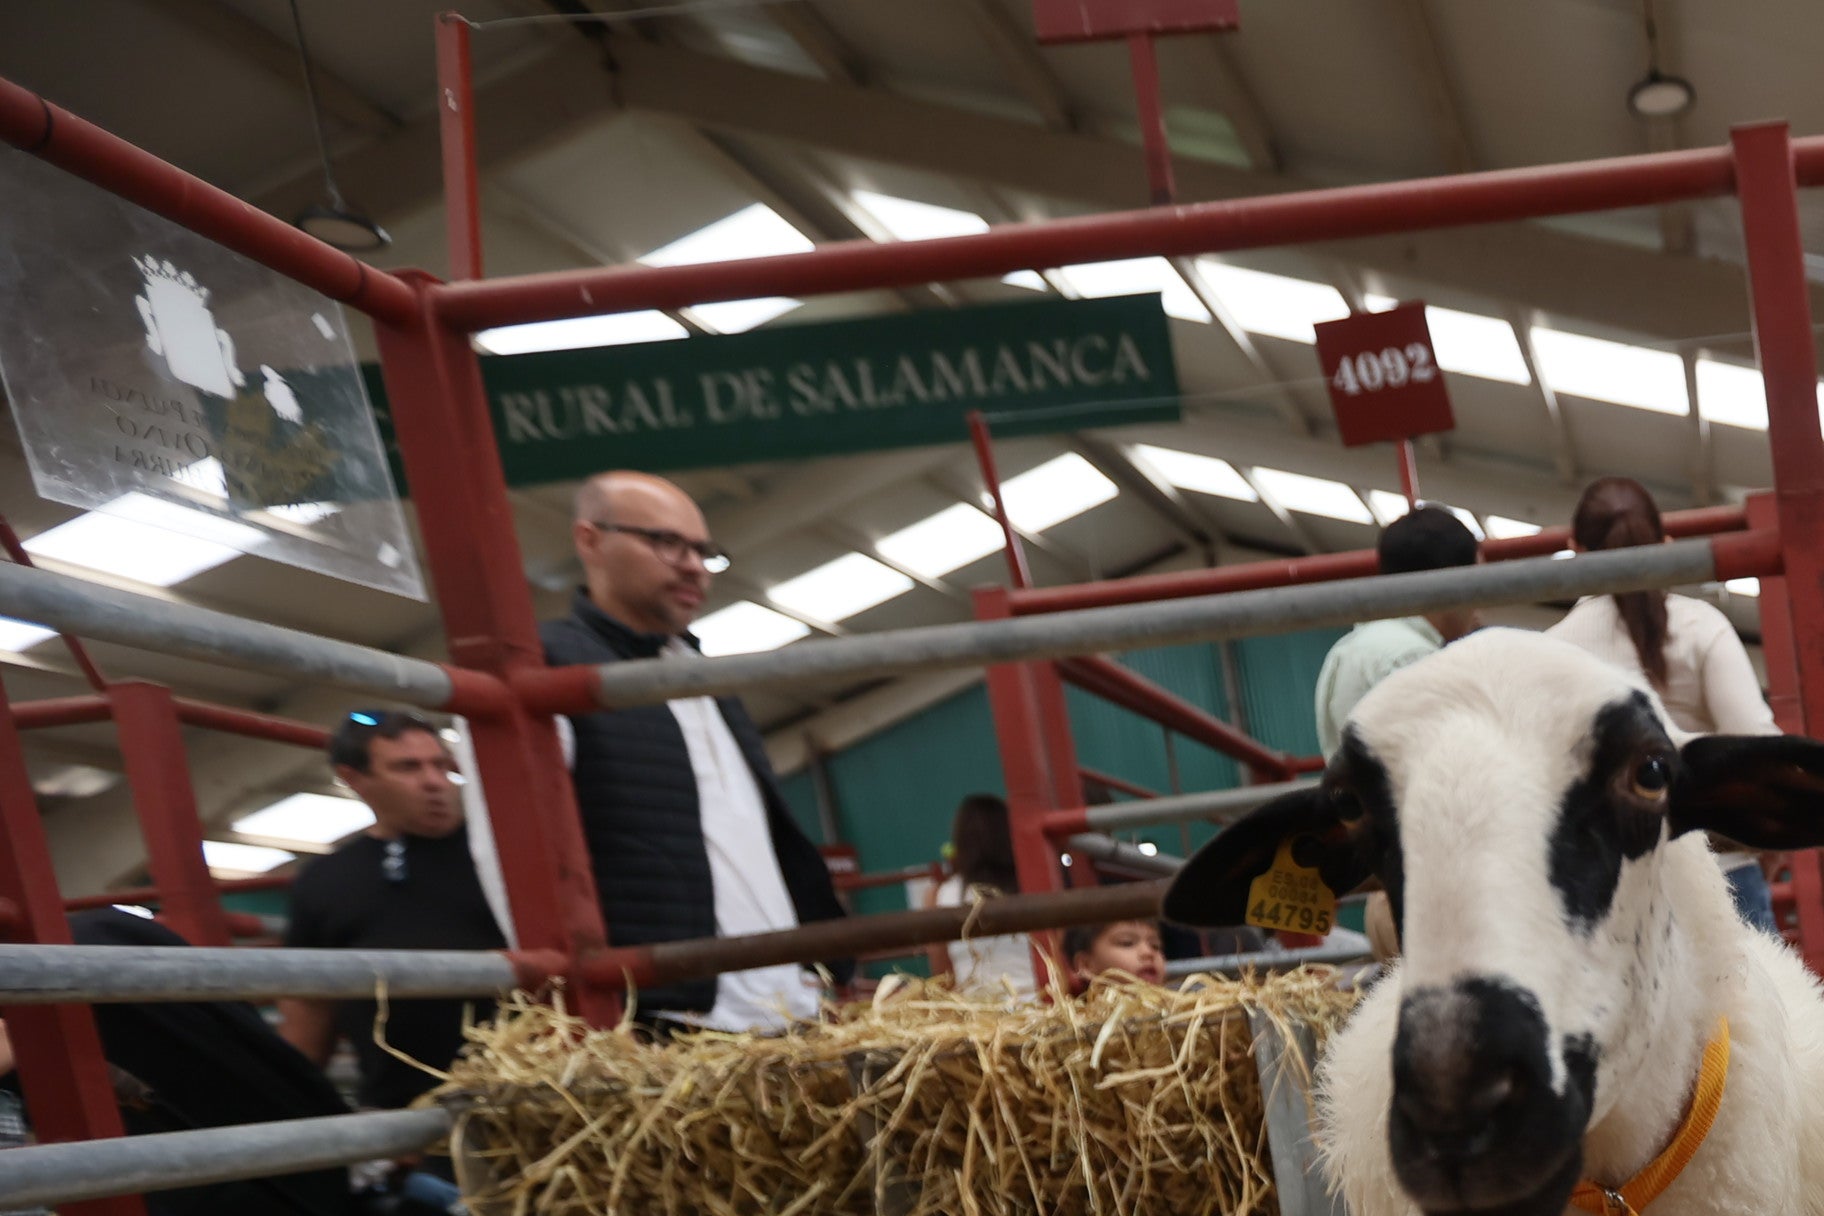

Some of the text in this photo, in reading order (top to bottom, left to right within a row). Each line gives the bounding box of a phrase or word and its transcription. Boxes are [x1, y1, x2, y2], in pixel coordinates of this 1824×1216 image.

[500, 333, 1149, 443] RURAL DE SALAMANCA
[1333, 342, 1436, 395] 4092
[1251, 899, 1330, 932] 44795
